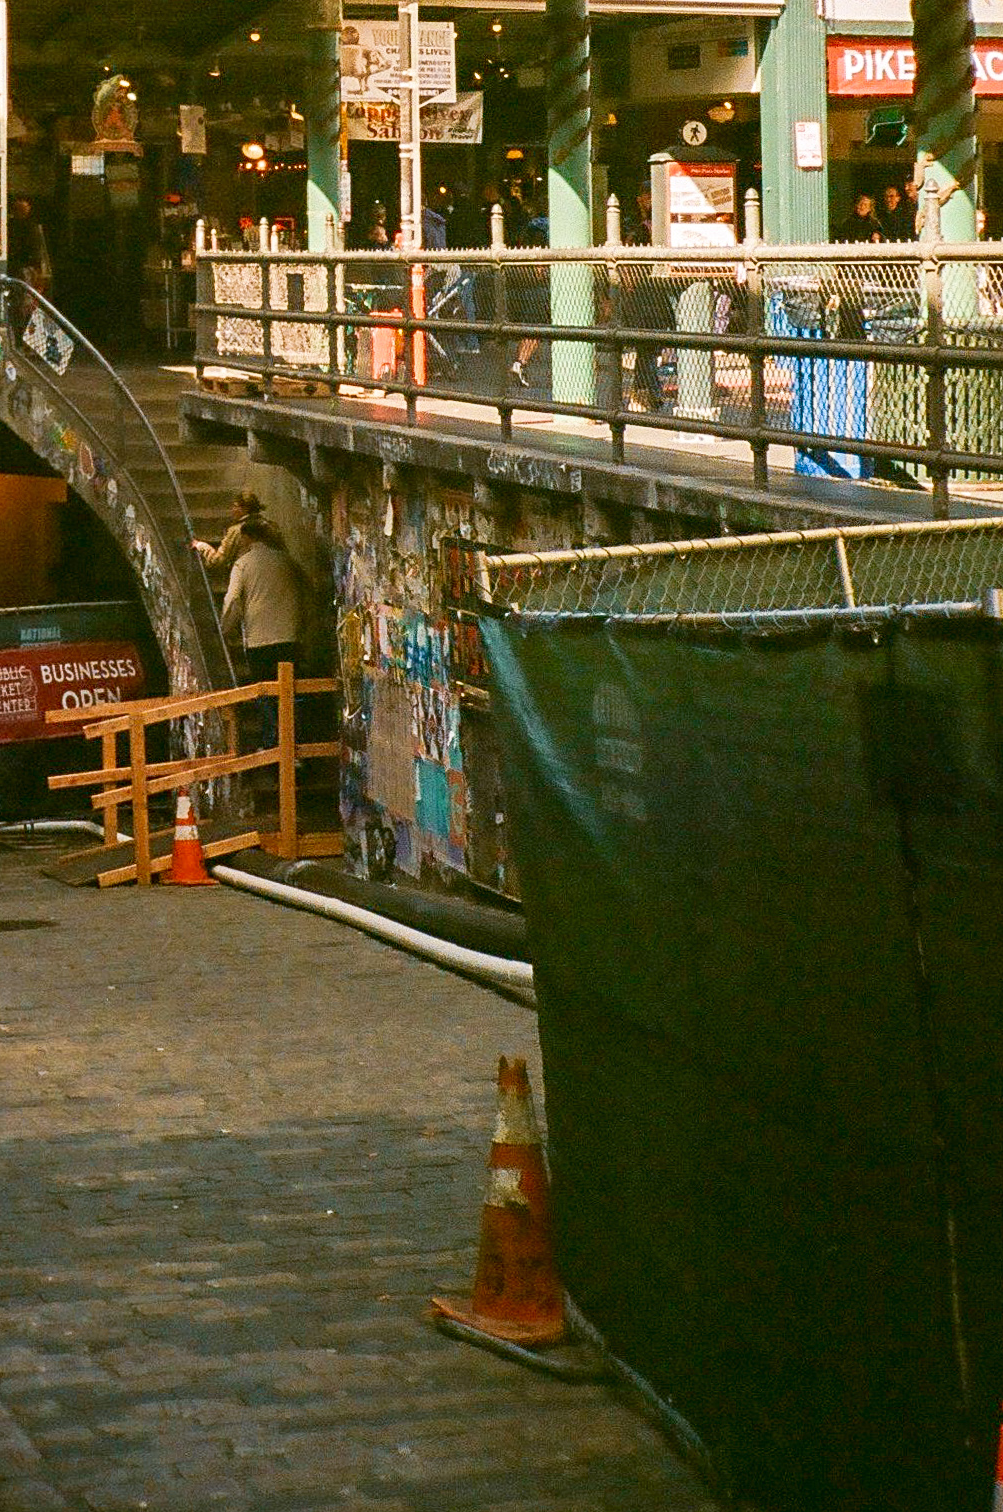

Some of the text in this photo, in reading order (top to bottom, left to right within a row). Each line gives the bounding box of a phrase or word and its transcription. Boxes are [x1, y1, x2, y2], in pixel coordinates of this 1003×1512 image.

[843, 49, 916, 81] PIKE
[367, 119, 444, 140] Salon
[40, 659, 136, 684] BUSINESSES
